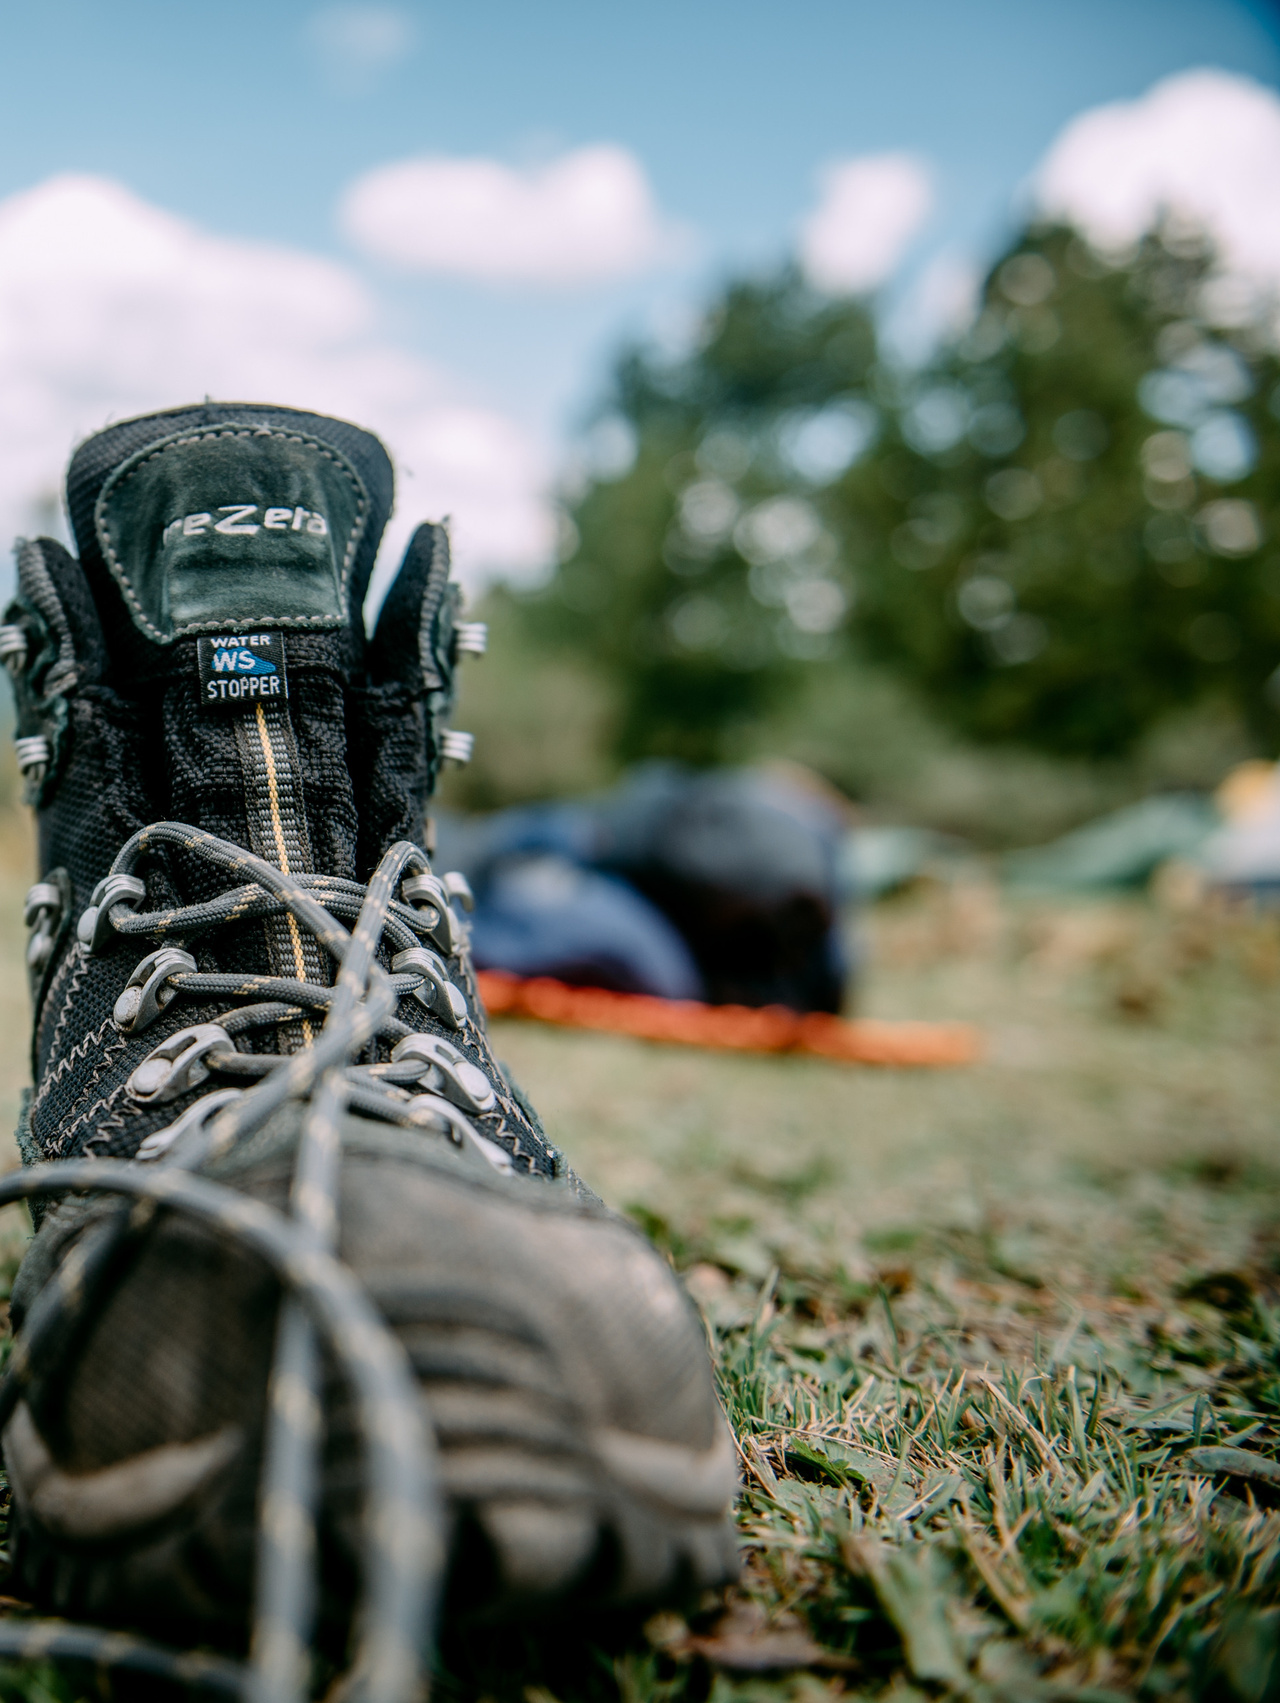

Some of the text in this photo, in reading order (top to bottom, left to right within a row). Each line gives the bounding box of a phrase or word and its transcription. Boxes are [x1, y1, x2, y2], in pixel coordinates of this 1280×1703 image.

[210, 634, 271, 649] WATER
[213, 650, 256, 673] WS
[207, 675, 280, 699] STOPPER
